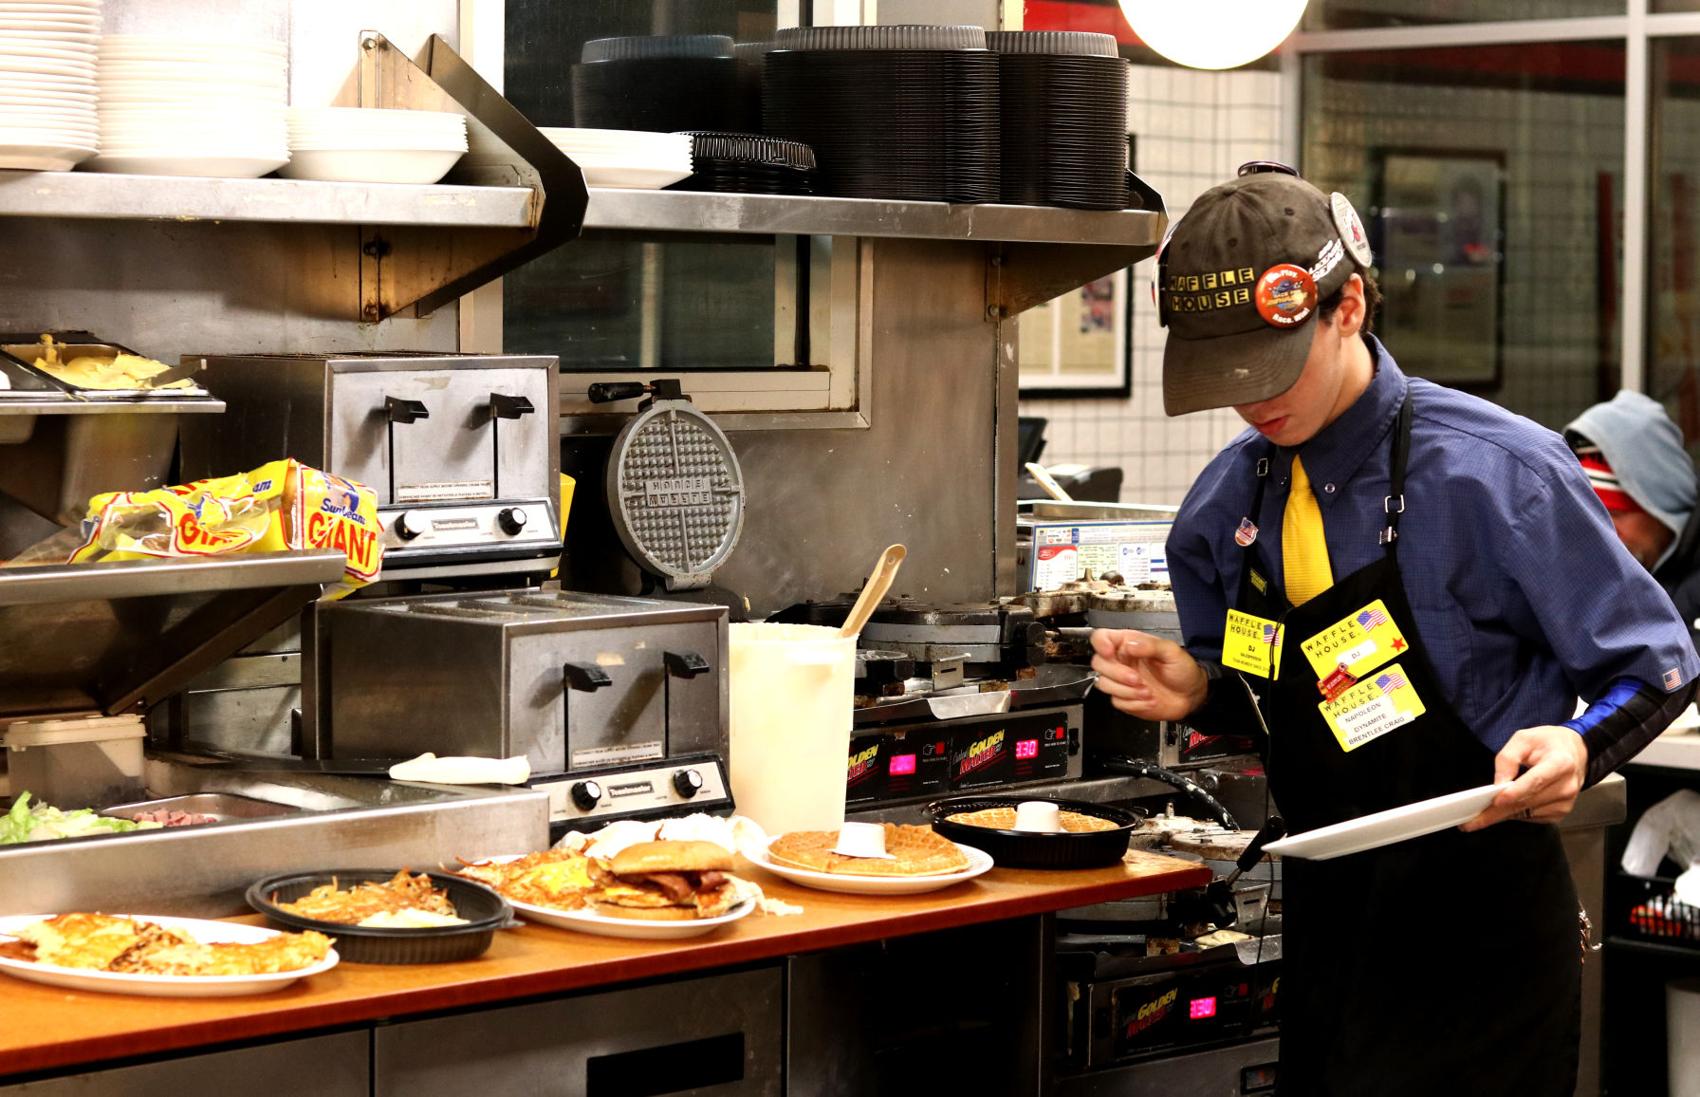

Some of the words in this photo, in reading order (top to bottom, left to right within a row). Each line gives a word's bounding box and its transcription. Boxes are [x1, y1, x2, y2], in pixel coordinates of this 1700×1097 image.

[1168, 266, 1255, 292] WAFFLE
[1172, 287, 1250, 312] HOUSE
[308, 511, 377, 568] GIANT
[1228, 613, 1262, 630] WAFFLE
[1305, 619, 1355, 652] WAFFLE
[1351, 650, 1361, 660] DJ
[1324, 682, 1374, 712] WAFFLE
[1345, 702, 1382, 723] NAPOLEON
[1353, 712, 1388, 733] DYNAMITE
[968, 729, 1005, 758] GOLDEN
[1348, 725, 1383, 746] BRENTLEE
[1383, 716, 1405, 730] CRAIG
[1137, 986, 1178, 1021] GOLDEN
